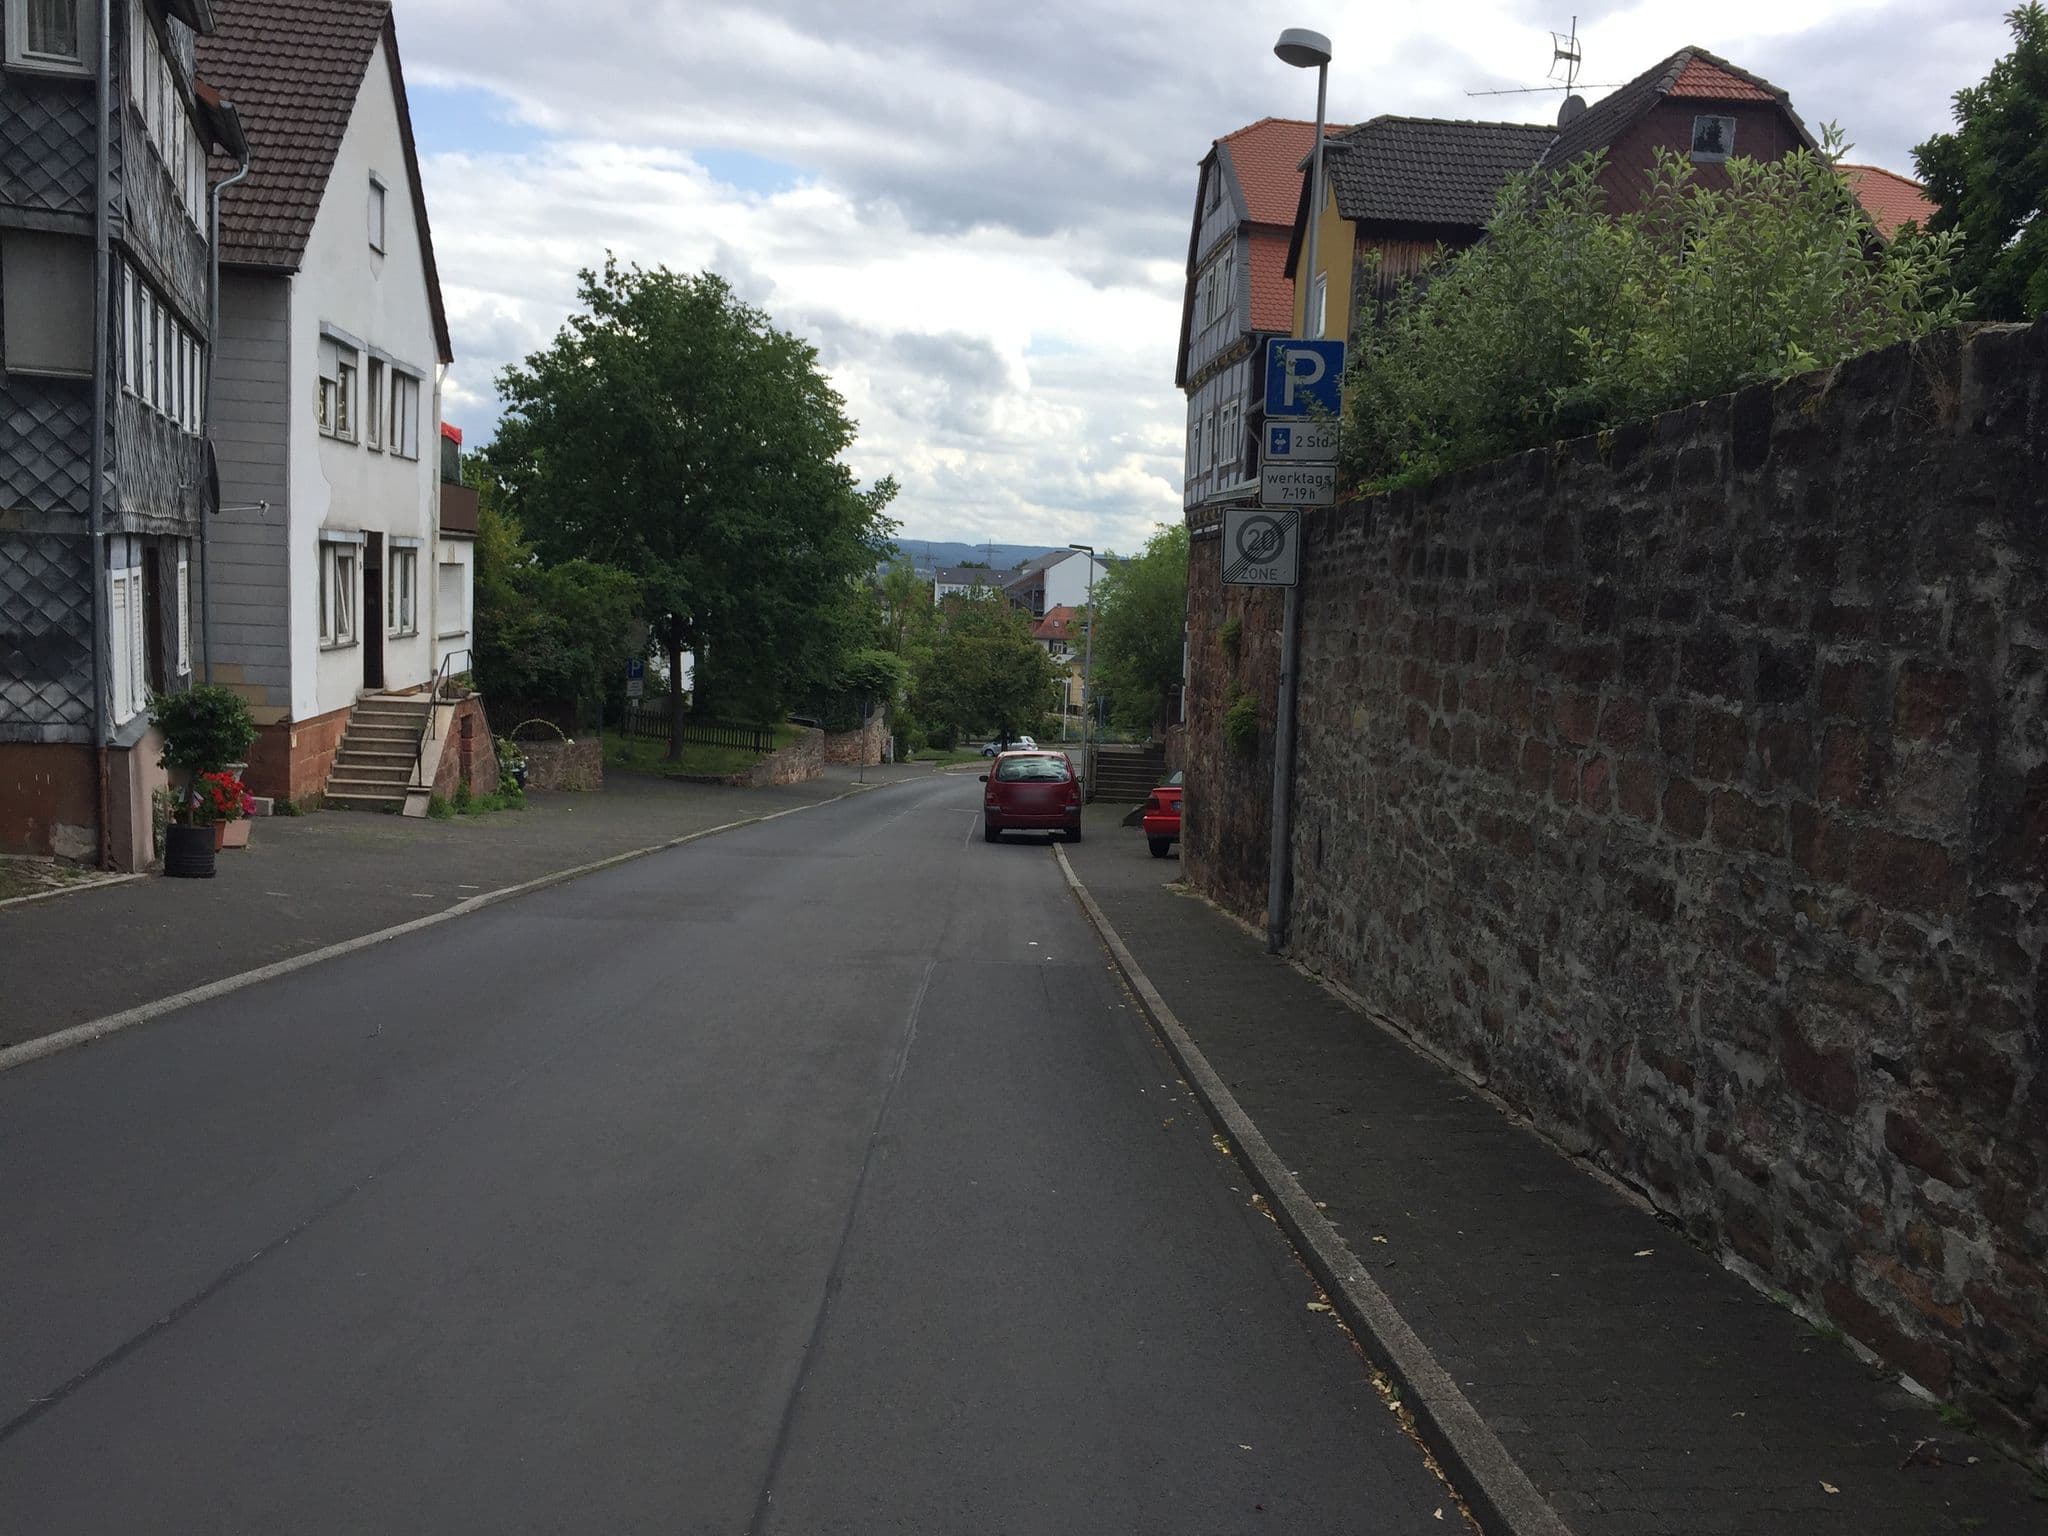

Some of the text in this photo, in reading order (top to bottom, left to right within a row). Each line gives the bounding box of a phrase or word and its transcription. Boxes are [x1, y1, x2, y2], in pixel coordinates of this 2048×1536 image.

[1283, 349, 1326, 406] P
[1296, 435, 1303, 448] 2
[1267, 472, 1332, 487] werktags
[1281, 487, 1316, 500] 7-19 h
[1247, 528, 1275, 551] 20
[1240, 567, 1278, 580] ZONE
